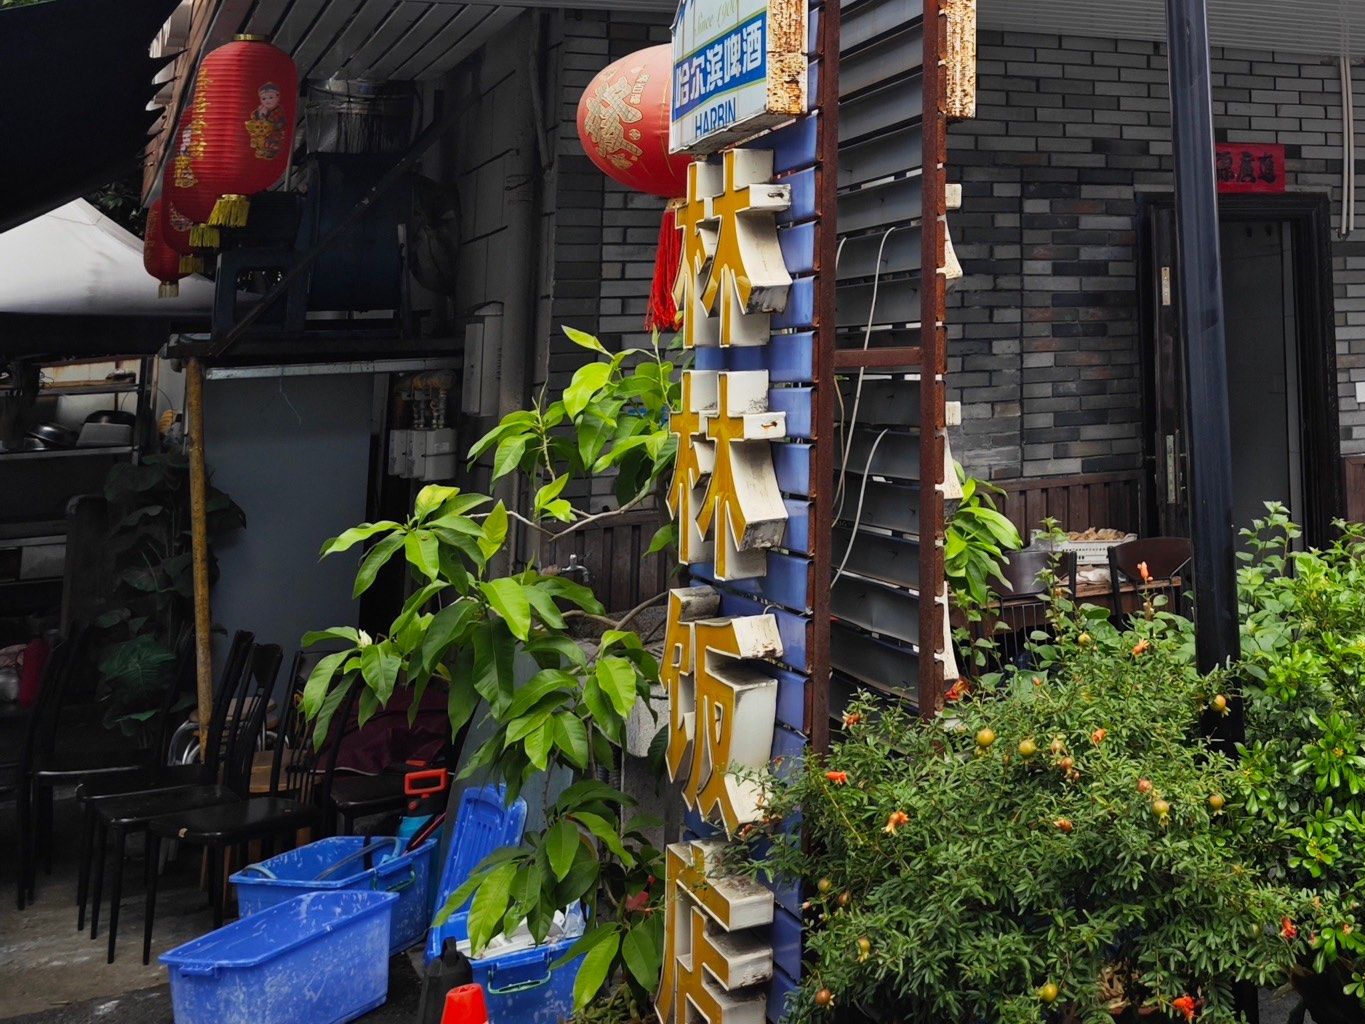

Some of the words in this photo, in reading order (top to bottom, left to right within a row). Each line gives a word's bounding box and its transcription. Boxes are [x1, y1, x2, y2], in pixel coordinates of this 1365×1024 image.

[675, 19, 763, 110] 哈尔滨啤酒
[694, 96, 737, 139] HARBIN
